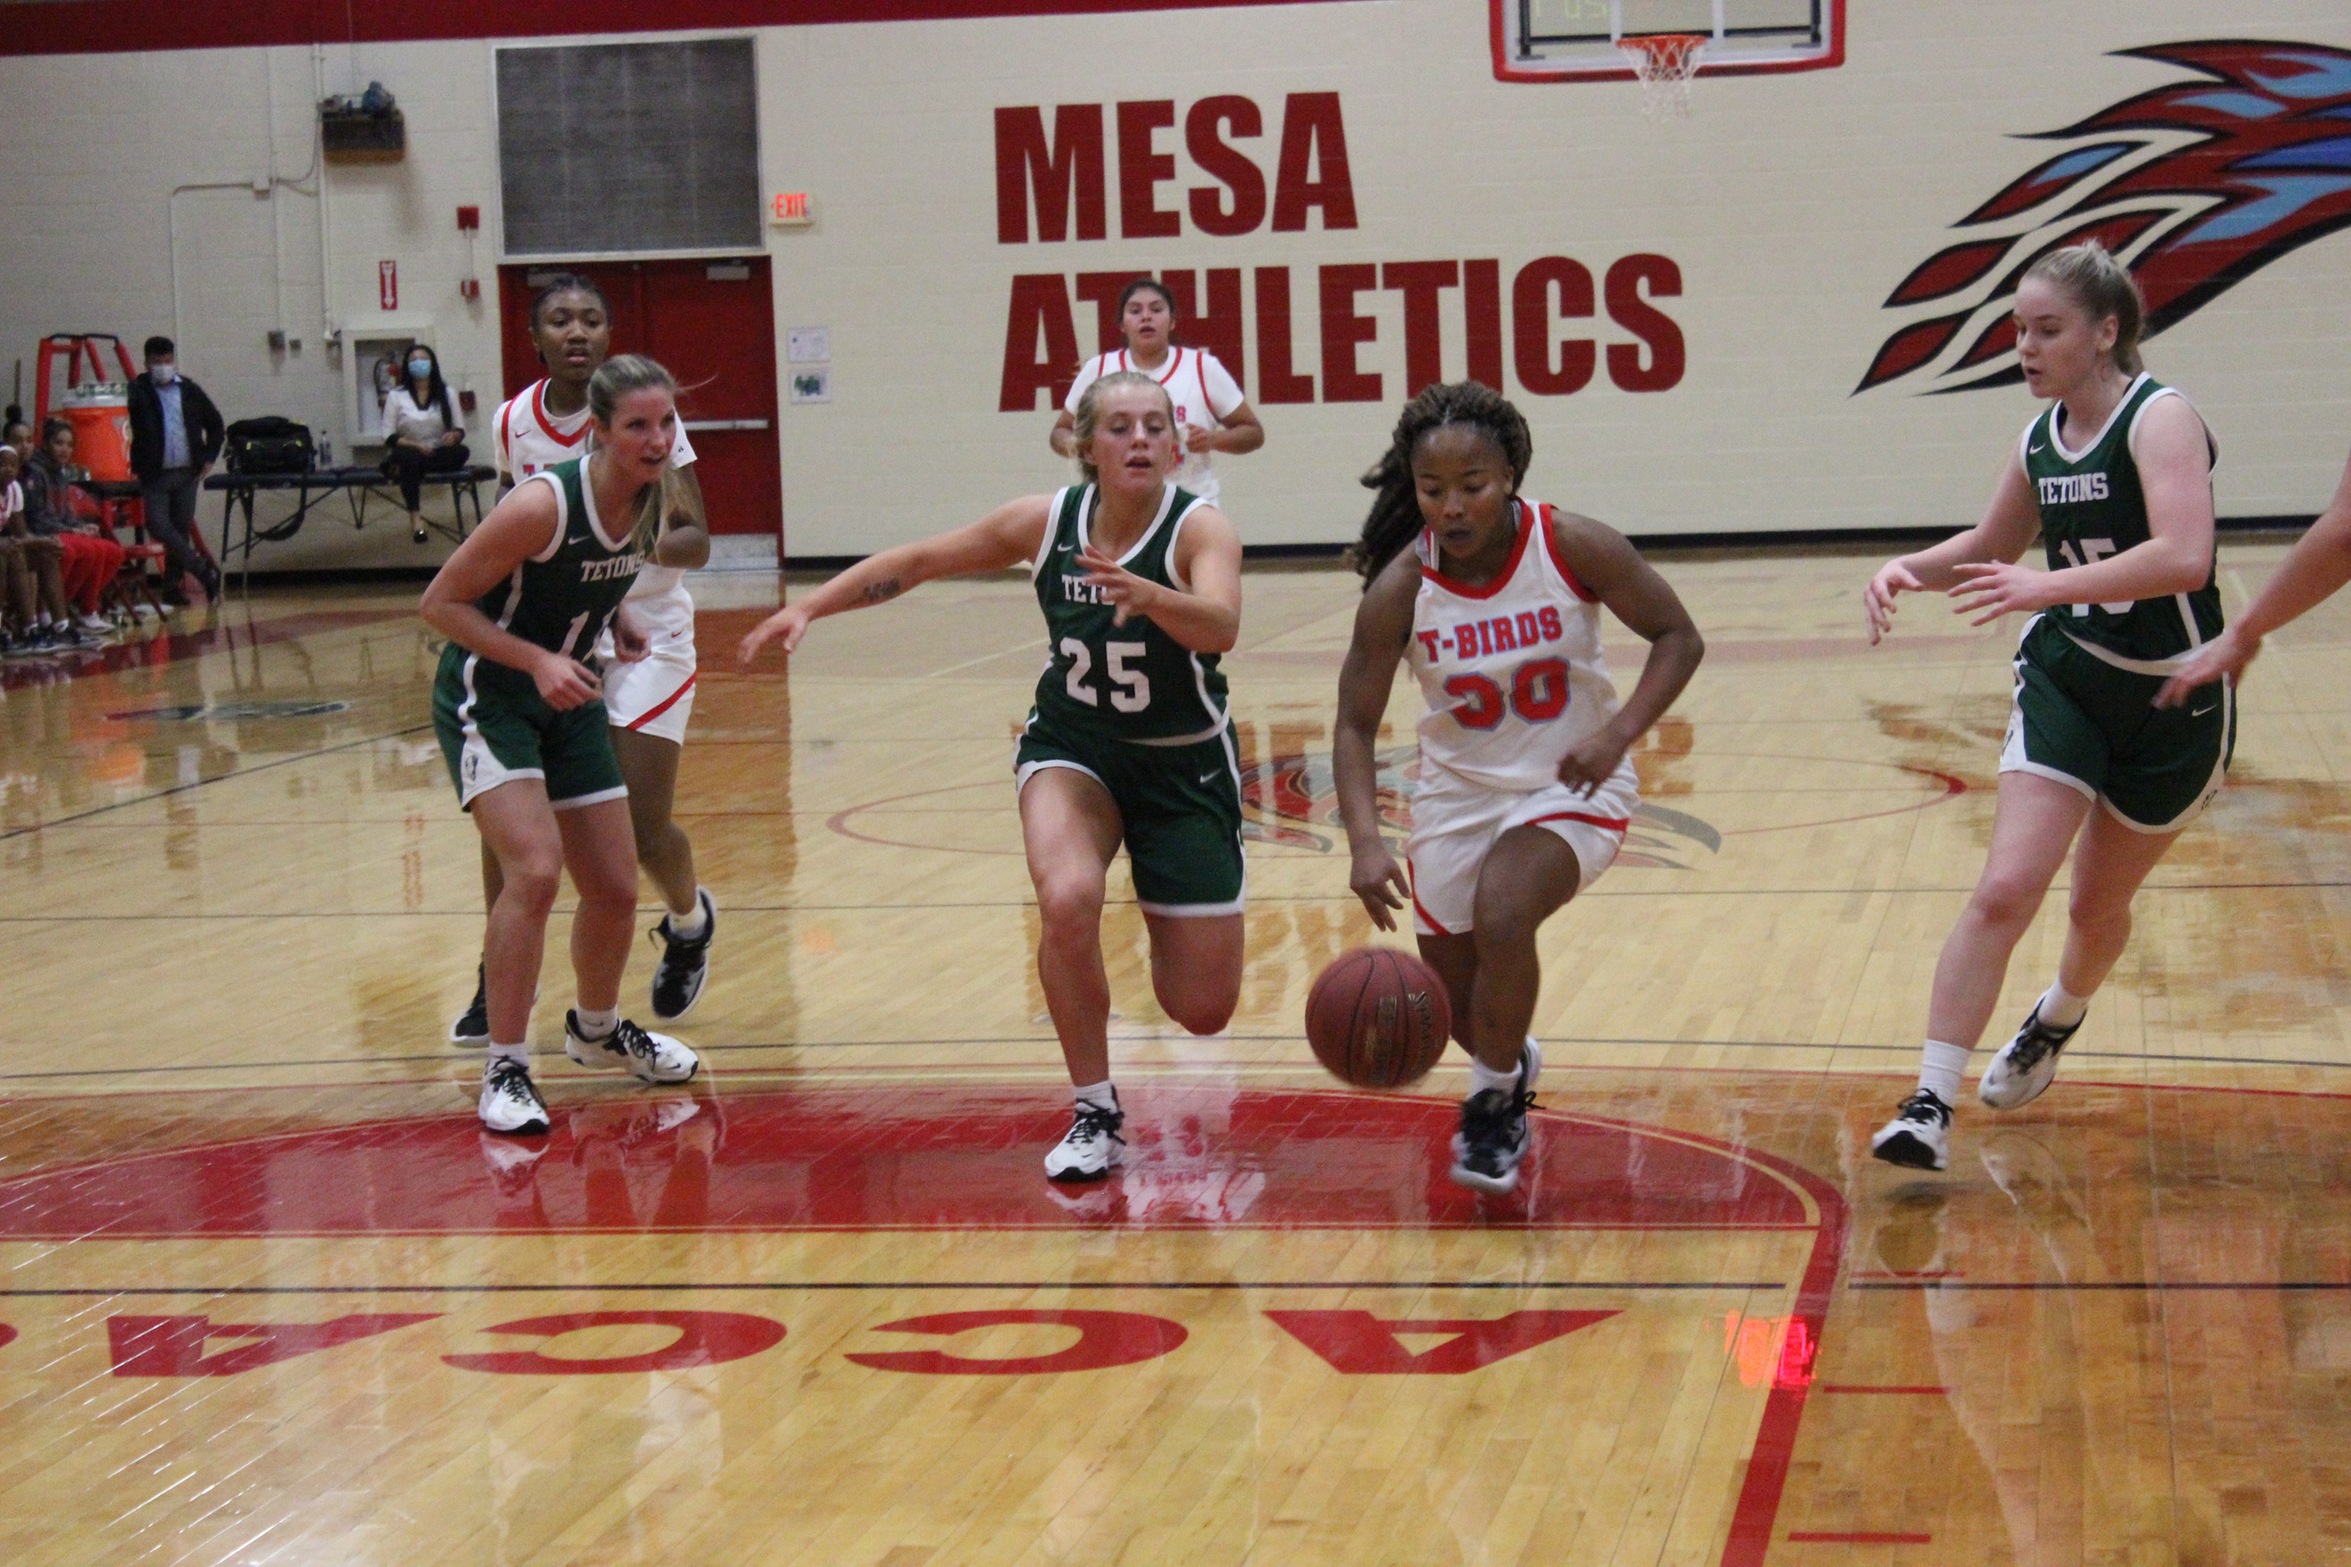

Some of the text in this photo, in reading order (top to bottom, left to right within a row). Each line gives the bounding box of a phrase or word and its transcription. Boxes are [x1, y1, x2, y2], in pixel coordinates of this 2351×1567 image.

[994, 92, 1358, 244] MESA
[775, 193, 807, 218] EXIT
[998, 253, 1685, 413] ATHLETICS
[2038, 472, 2110, 505] TETONS
[580, 550, 646, 583] TETONS
[1061, 573, 1116, 606] TET
[1416, 604, 1563, 663] T-BIRDS
[1059, 636, 1151, 714] 25
[0, 1309, 1625, 1377] ACCA
